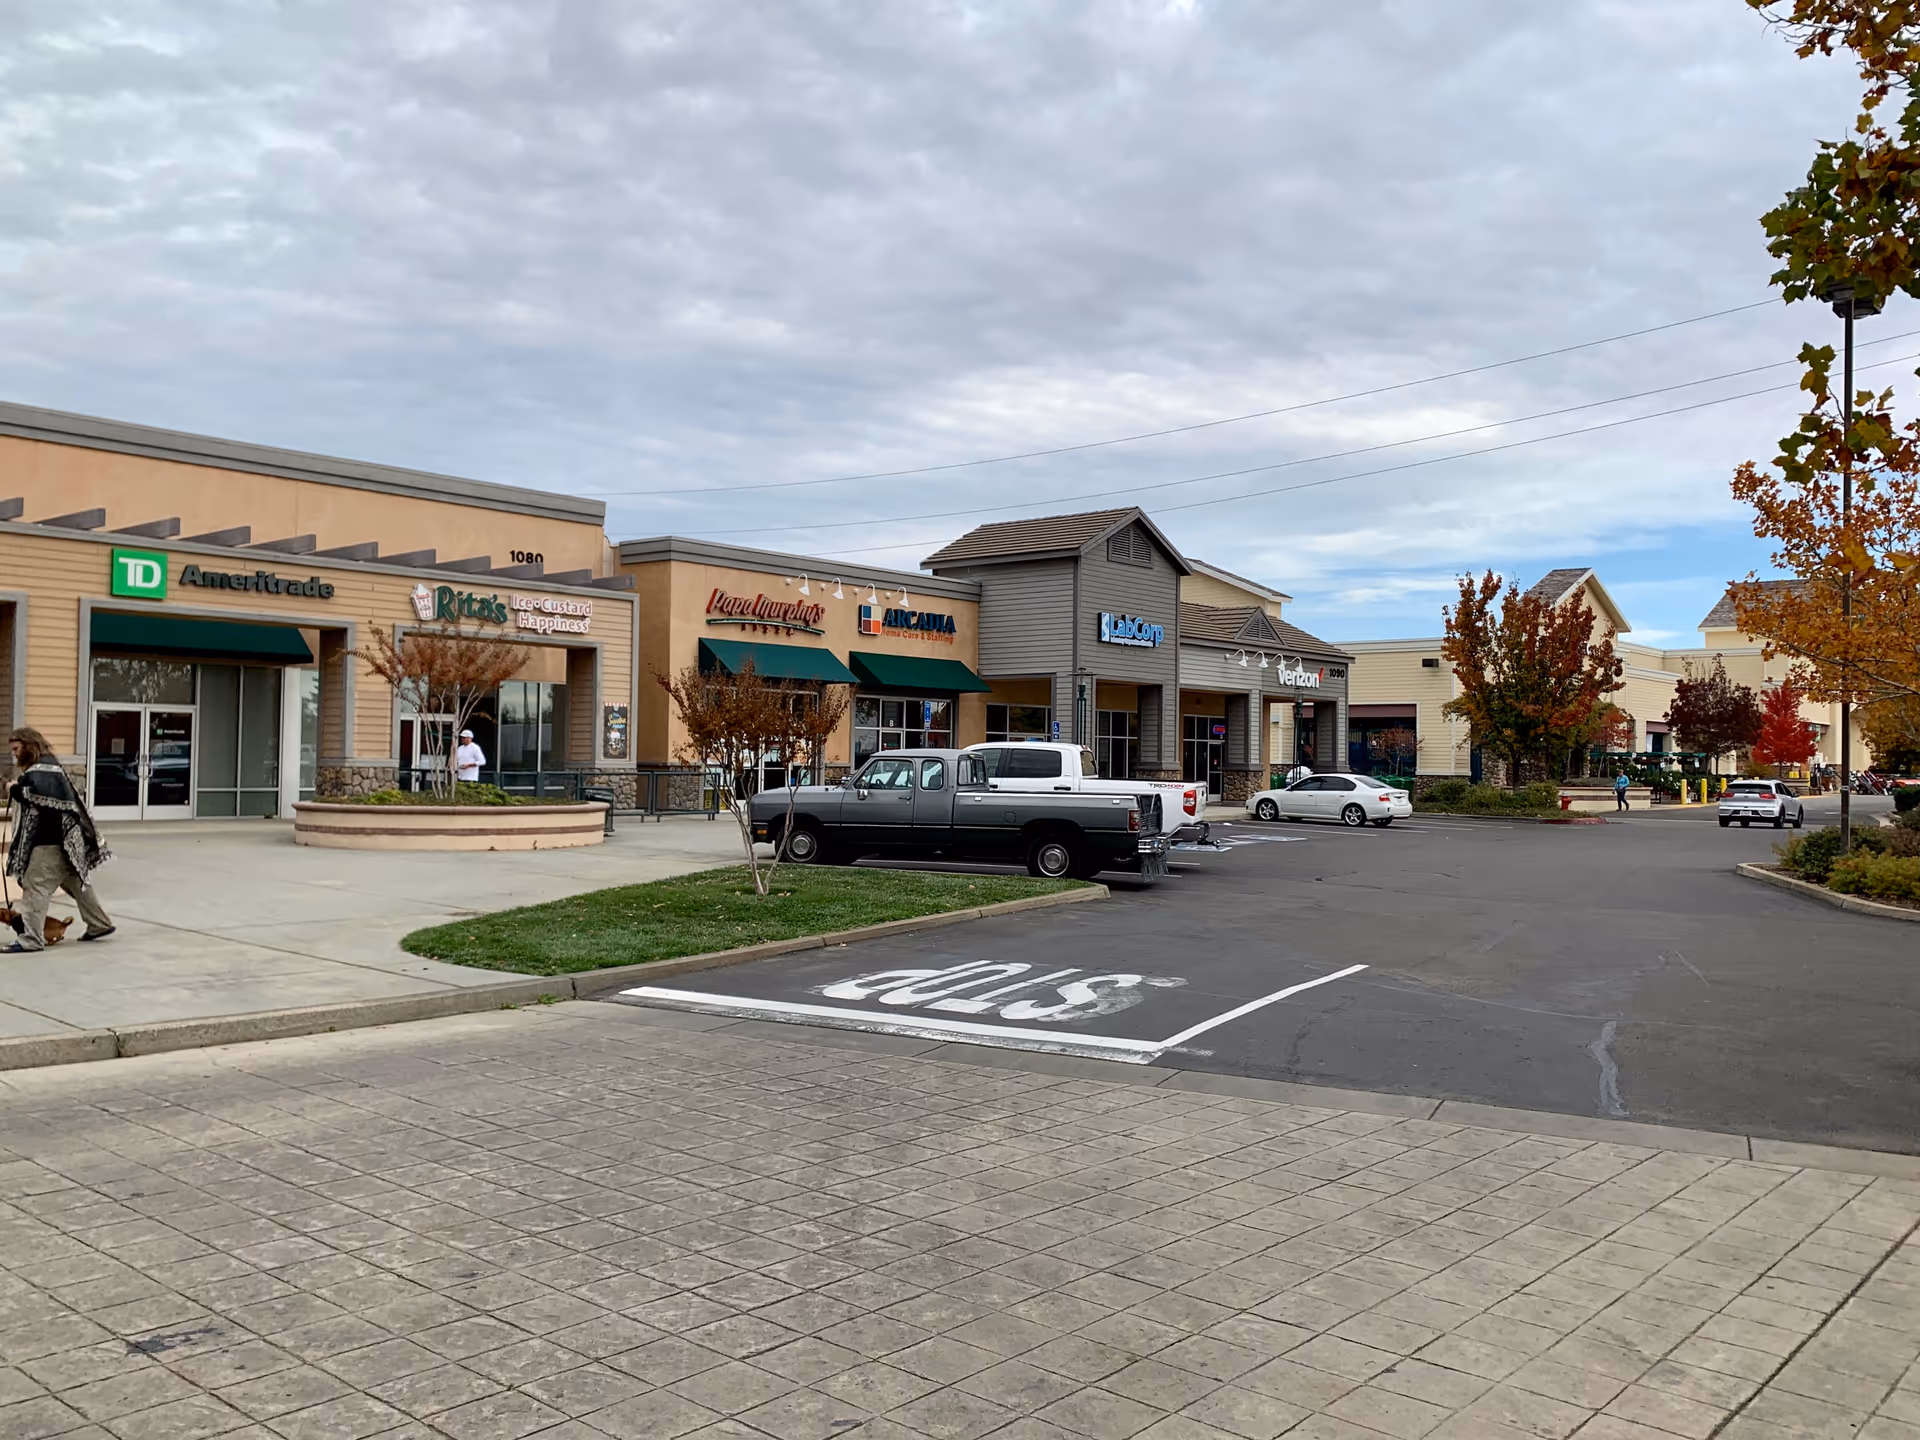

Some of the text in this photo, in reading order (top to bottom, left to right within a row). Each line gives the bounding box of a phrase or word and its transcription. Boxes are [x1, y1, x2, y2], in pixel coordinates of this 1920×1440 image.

[510, 550, 544, 564] 1080
[119, 557, 335, 599] TD Ameritrade
[436, 585, 508, 624] Rita's
[706, 588, 825, 626] Papa Murphy's
[518, 612, 590, 634] Happiness
[882, 608, 957, 634] ARCADIA
[1110, 613, 1164, 648] LabCorp
[881, 628, 954, 645] Home Care & Staffing
[1278, 669, 1320, 689] verizon
[821, 960, 1144, 1020] STOP
